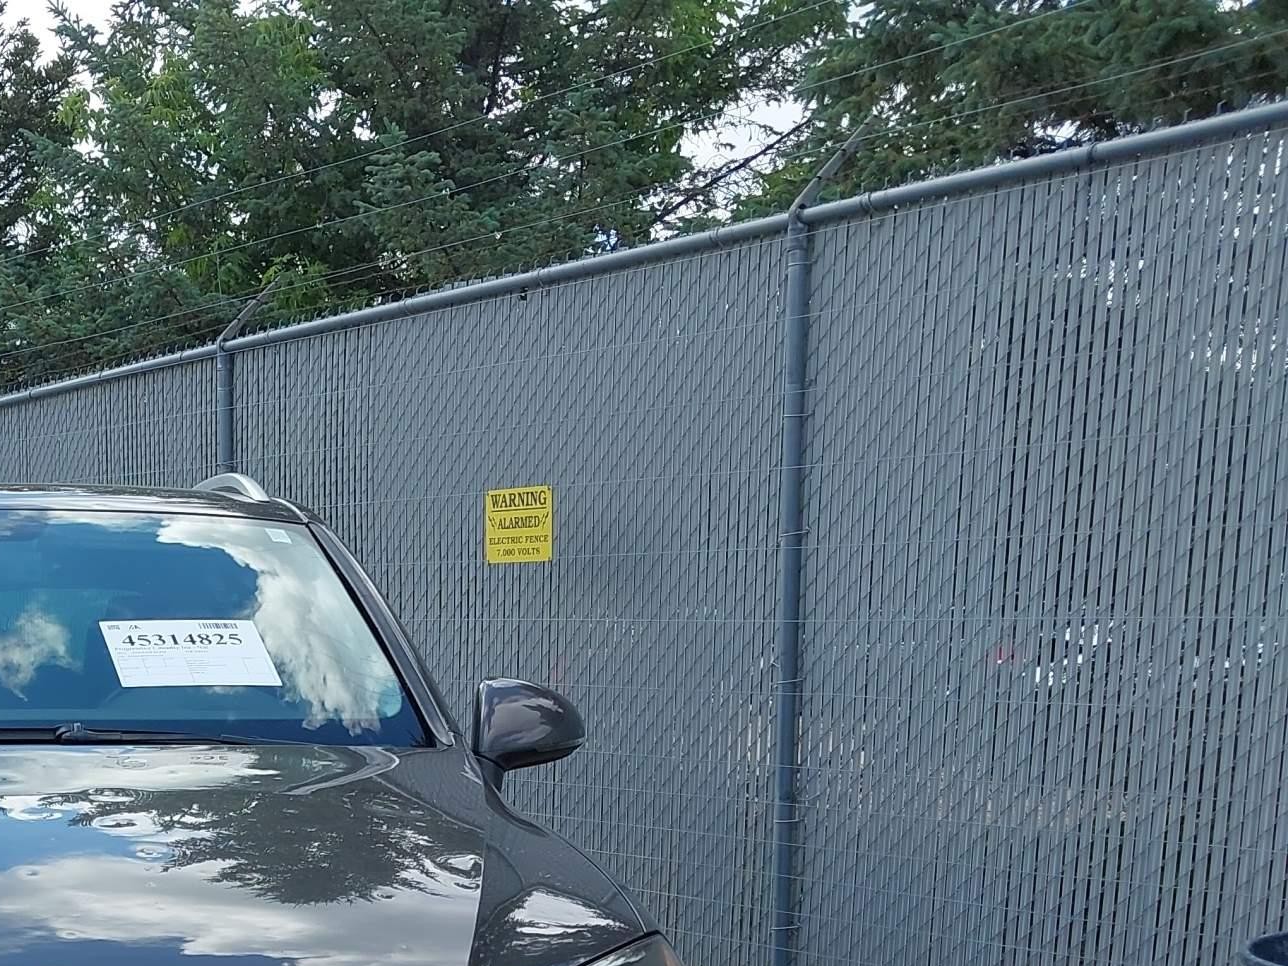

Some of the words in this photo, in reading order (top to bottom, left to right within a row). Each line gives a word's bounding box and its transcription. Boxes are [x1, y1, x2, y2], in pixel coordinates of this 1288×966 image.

[490, 490, 547, 509] WARNING
[497, 515, 540, 530] ALARMED
[489, 536, 523, 545] ELECTRIC
[525, 534, 549, 544] FENCE
[497, 548, 515, 557] 7,000
[517, 547, 540, 556] VOLTS
[122, 633, 242, 646] 45314825
